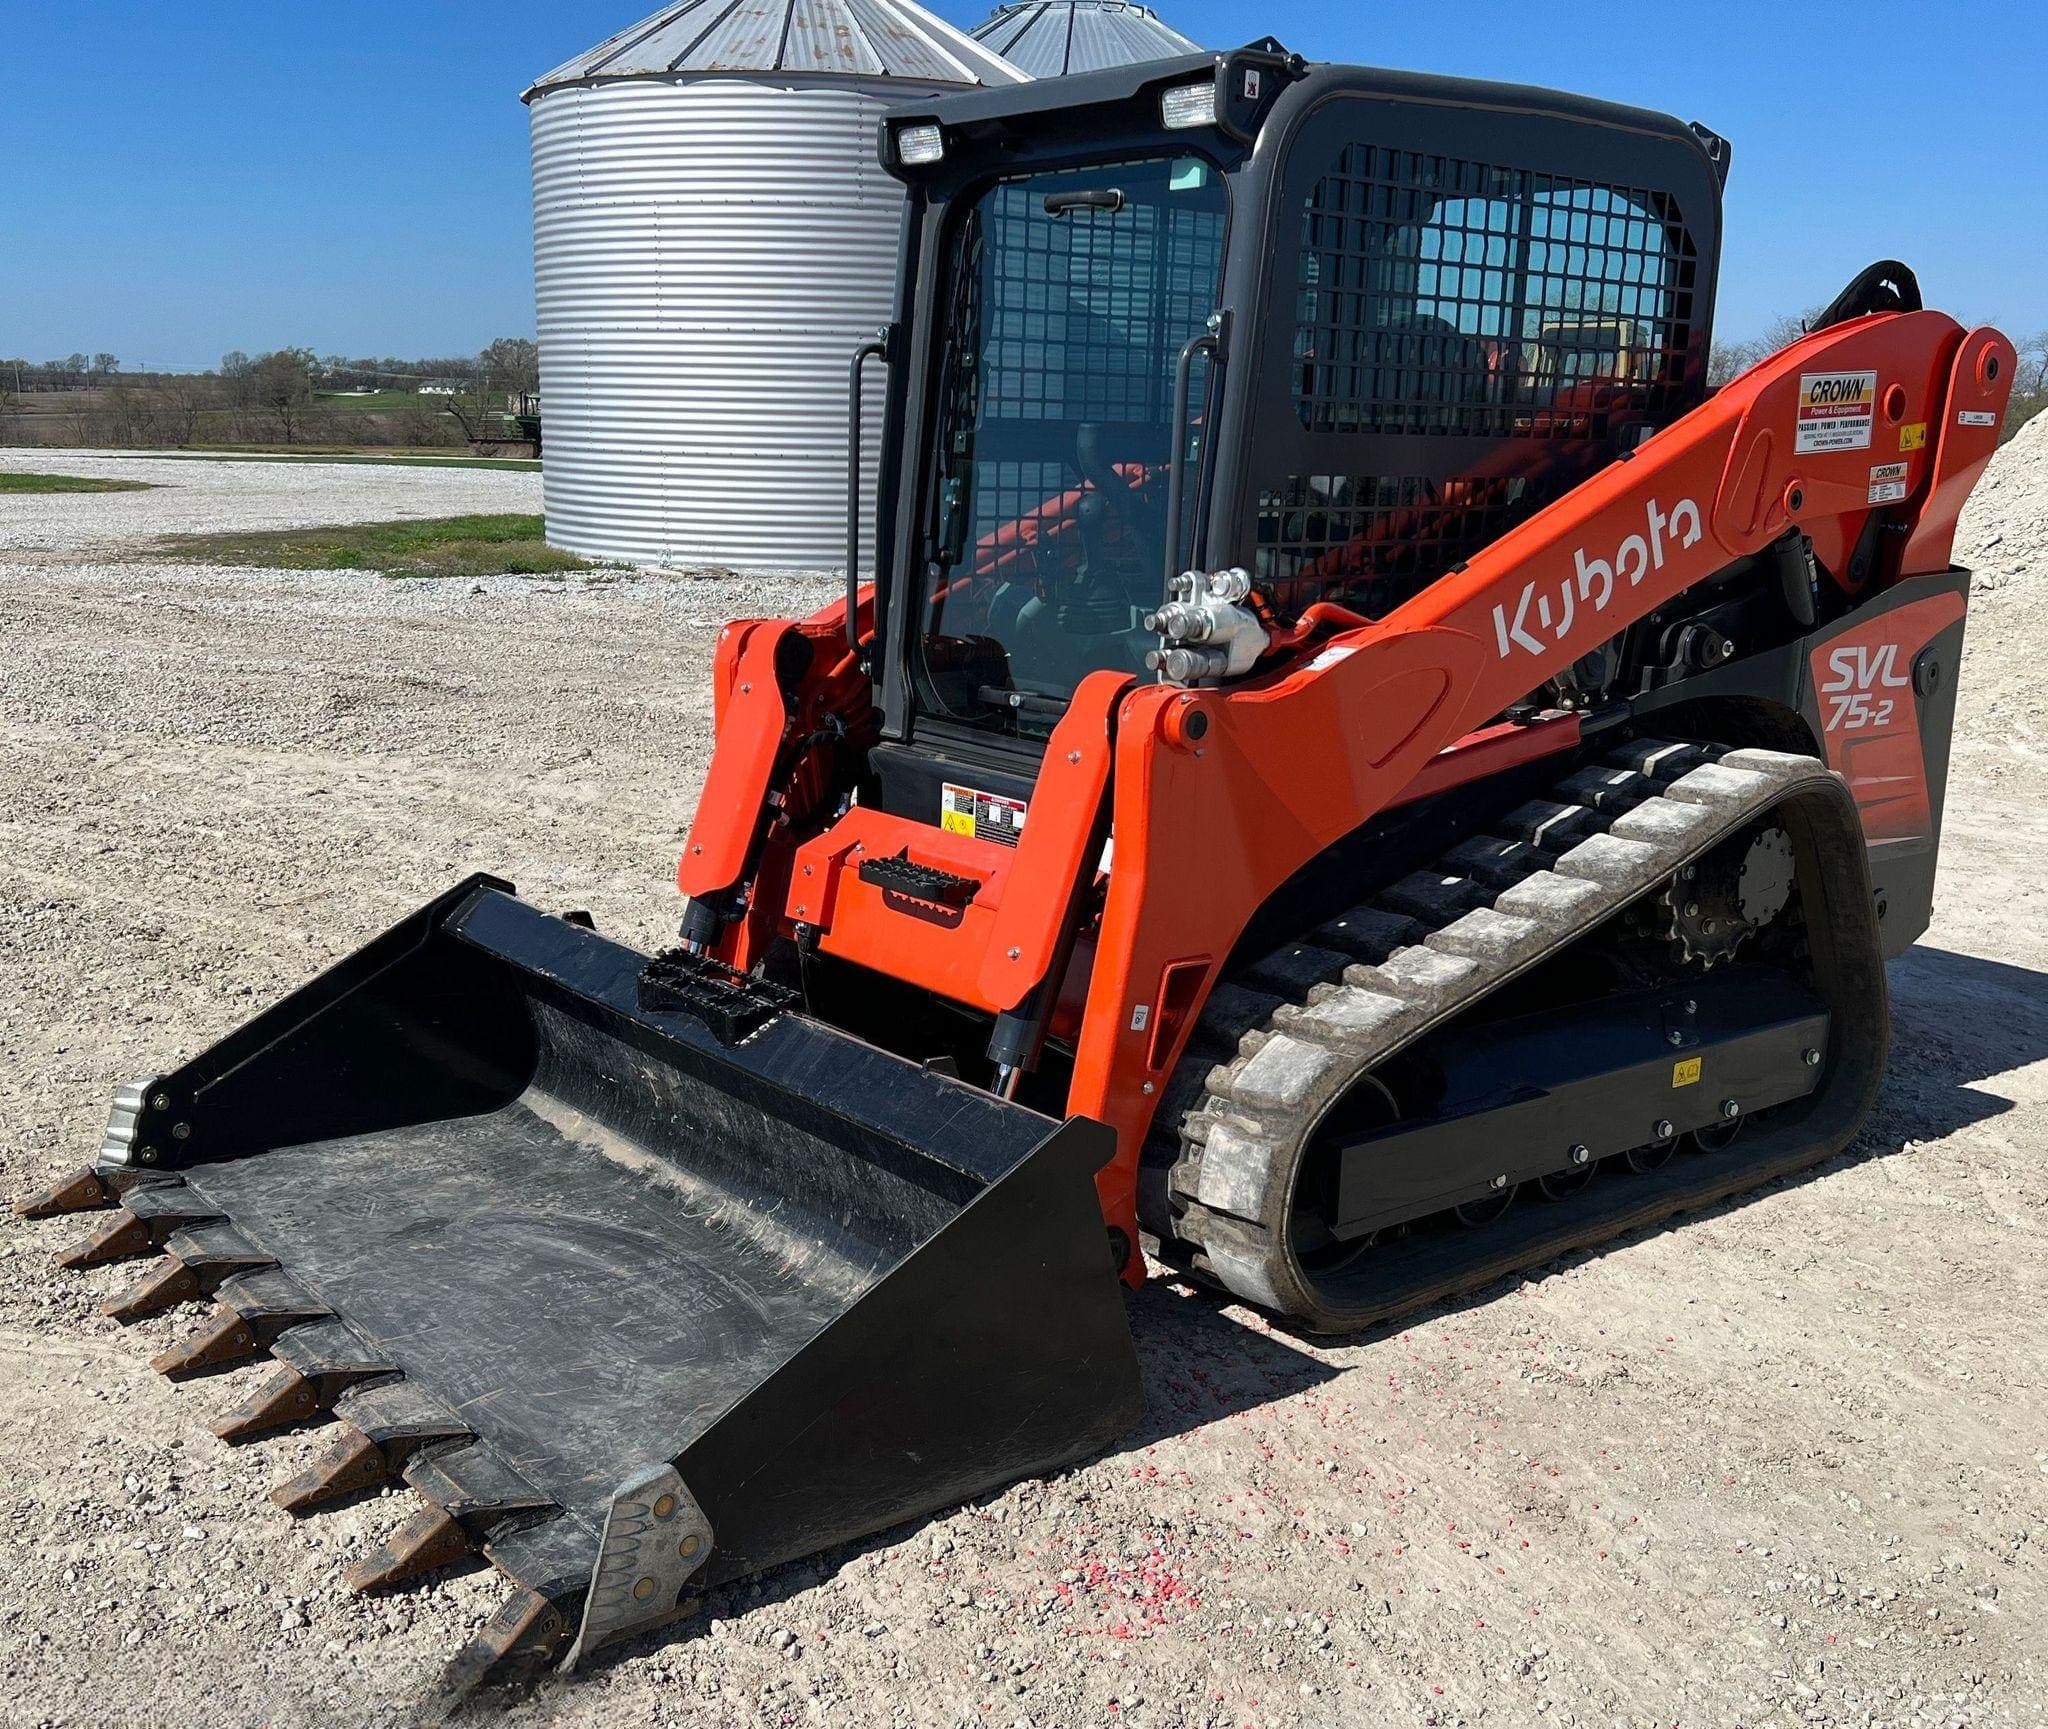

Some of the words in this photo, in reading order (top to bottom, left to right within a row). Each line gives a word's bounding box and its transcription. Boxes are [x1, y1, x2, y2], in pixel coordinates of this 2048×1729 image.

[1810, 379, 1865, 403] CROWN
[1811, 407, 1828, 415] Power
[1828, 406, 1833, 414] &
[1834, 405, 1862, 416] Equipment
[1798, 422, 1818, 431] PASSION
[1820, 421, 1837, 430] POWER
[1840, 419, 1870, 429] PERFORMANCE
[1876, 465, 1902, 479] CROWN
[1492, 498, 1702, 658] Kubota
[1821, 644, 1909, 692] SVL
[1825, 693, 1893, 732] 75-2
